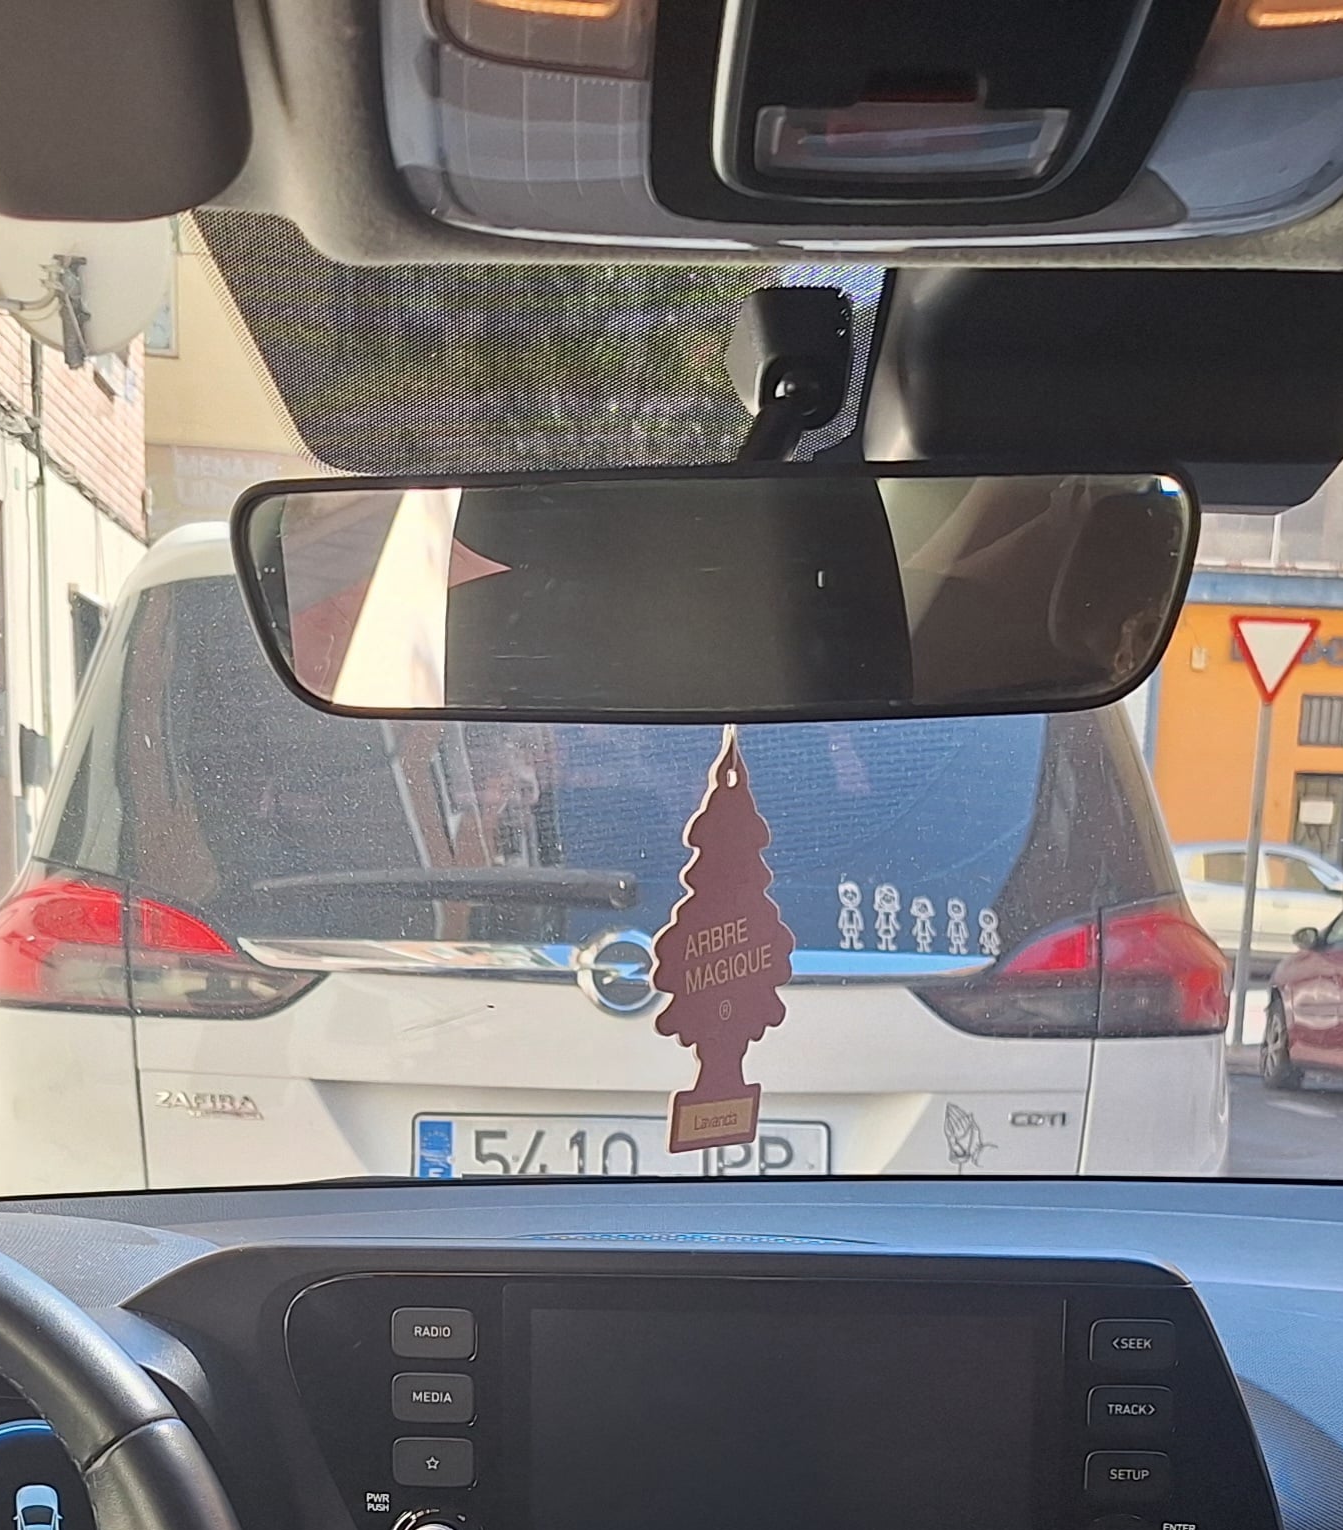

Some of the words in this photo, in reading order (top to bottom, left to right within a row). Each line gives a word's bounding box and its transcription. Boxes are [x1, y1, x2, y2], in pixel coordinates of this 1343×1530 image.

[684, 917, 749, 961] ARBRE
[685, 944, 772, 995] MAGIQUE
[155, 1091, 260, 1115] ZAFIRA
[693, 1110, 738, 1131] Lavanda
[474, 1129, 639, 1176] 5410
[414, 1326, 452, 1338] RADIO
[412, 1391, 453, 1403] MEDIA
[1109, 1468, 1150, 1481] SETUP
[366, 1492, 390, 1503] PWR
[367, 1503, 390, 1513] PUSH
